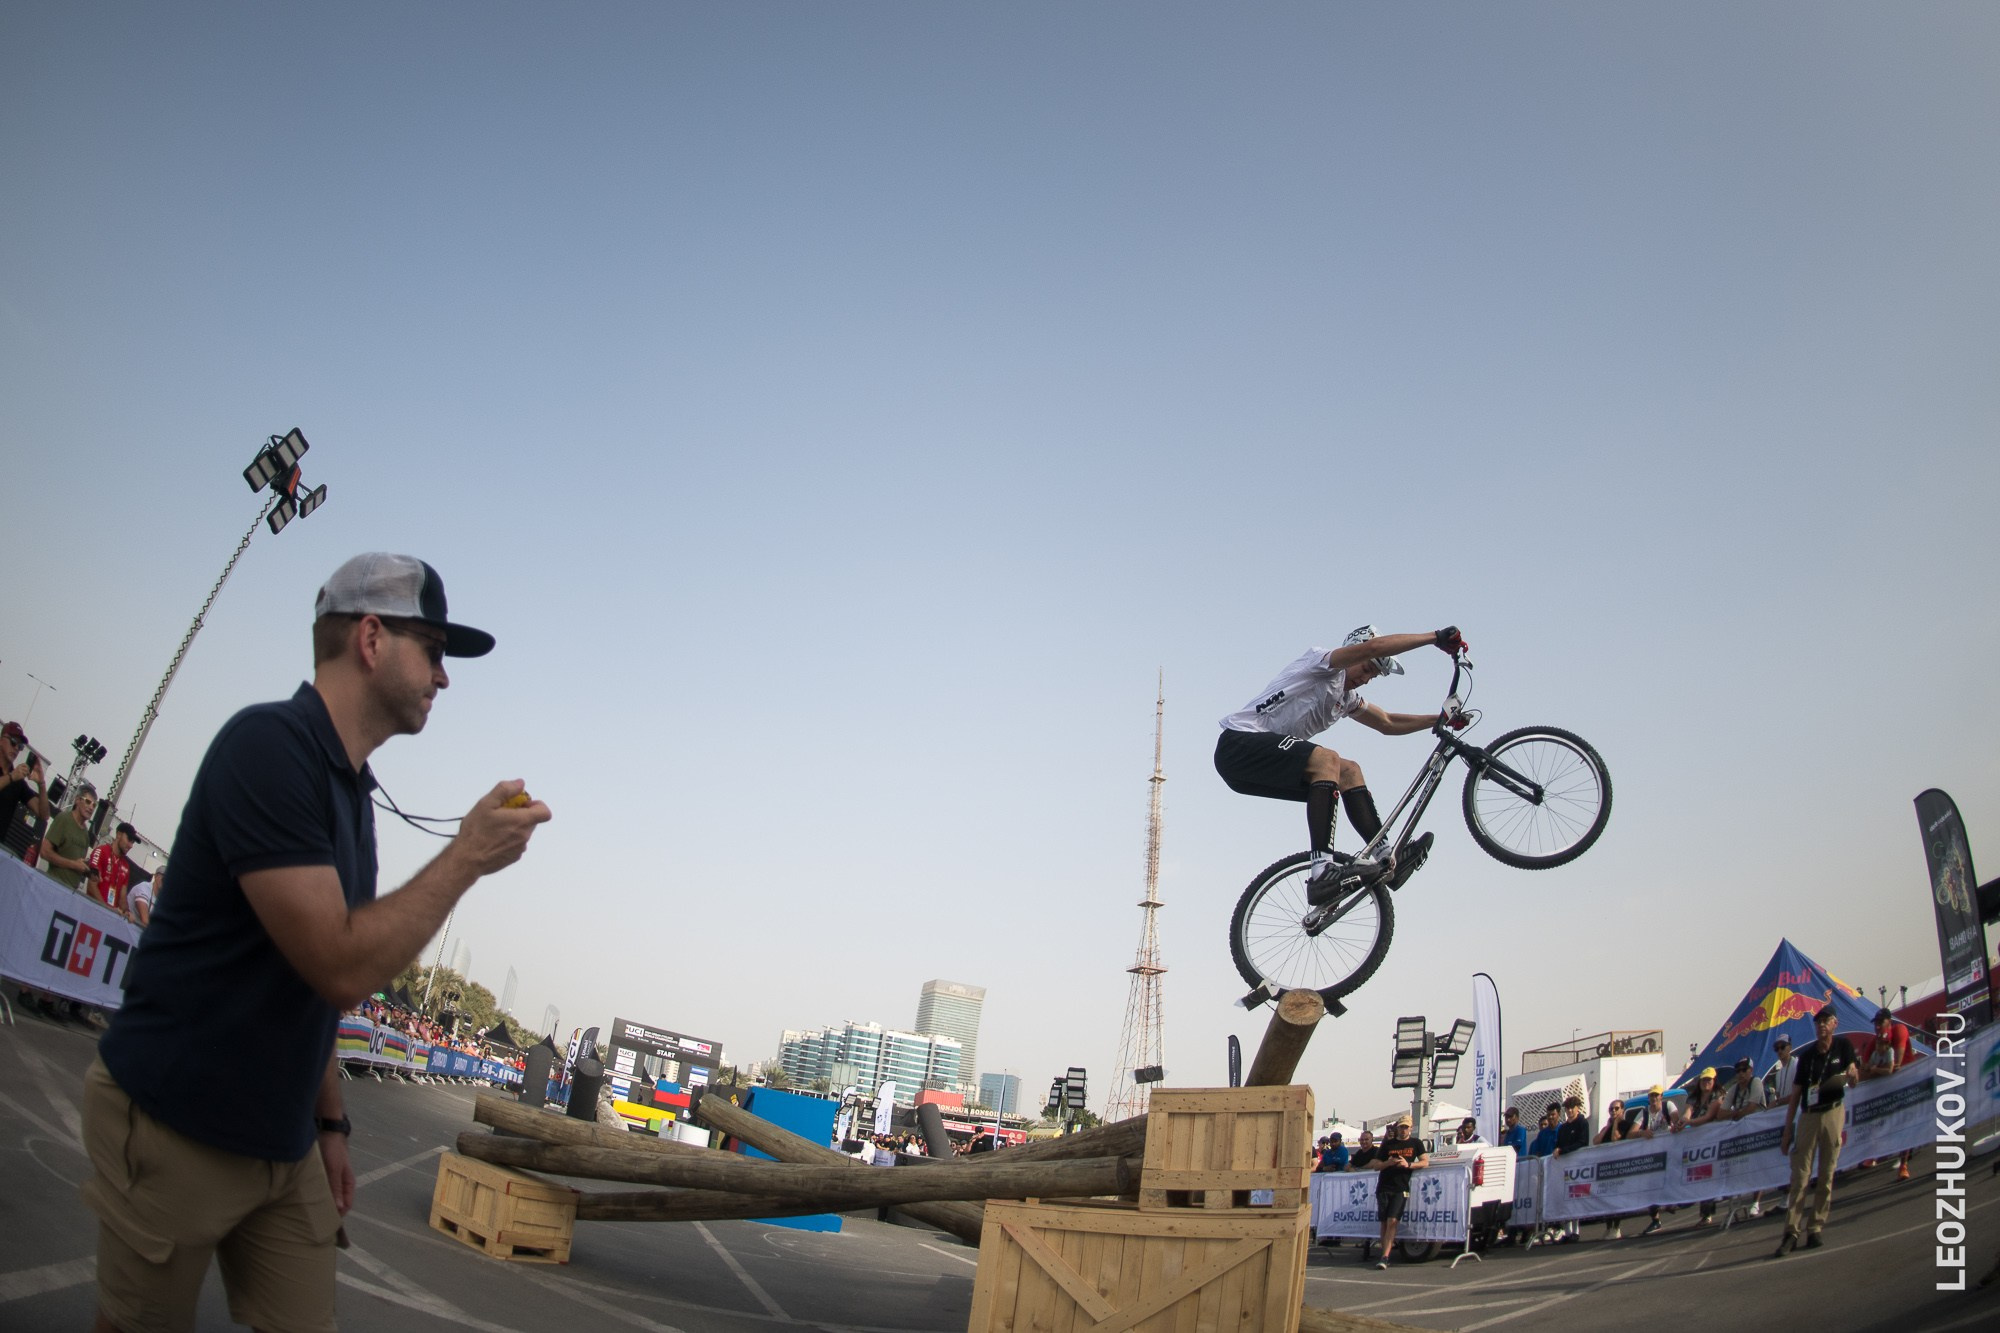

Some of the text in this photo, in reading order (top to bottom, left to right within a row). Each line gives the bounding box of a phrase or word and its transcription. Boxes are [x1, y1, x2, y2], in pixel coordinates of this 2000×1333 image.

[1256, 690, 1285, 713] KTM
[1779, 969, 1811, 985] Bull
[369, 1029, 386, 1055] UCI
[656, 1049, 676, 1058] START
[937, 1103, 968, 1114] BONJOUR
[1003, 1112, 1021, 1120] CAFE
[1689, 1146, 1716, 1162] UCI
[1720, 1146, 1742, 1156] WORLD
[1612, 1161, 1630, 1169] URBAN
[1631, 1157, 1654, 1166] CYCLING
[1619, 1162, 1664, 1174] CHAMPIONSHIPS
[1570, 1167, 1594, 1180] UCI
[1402, 1210, 1458, 1223] BURJEEL
